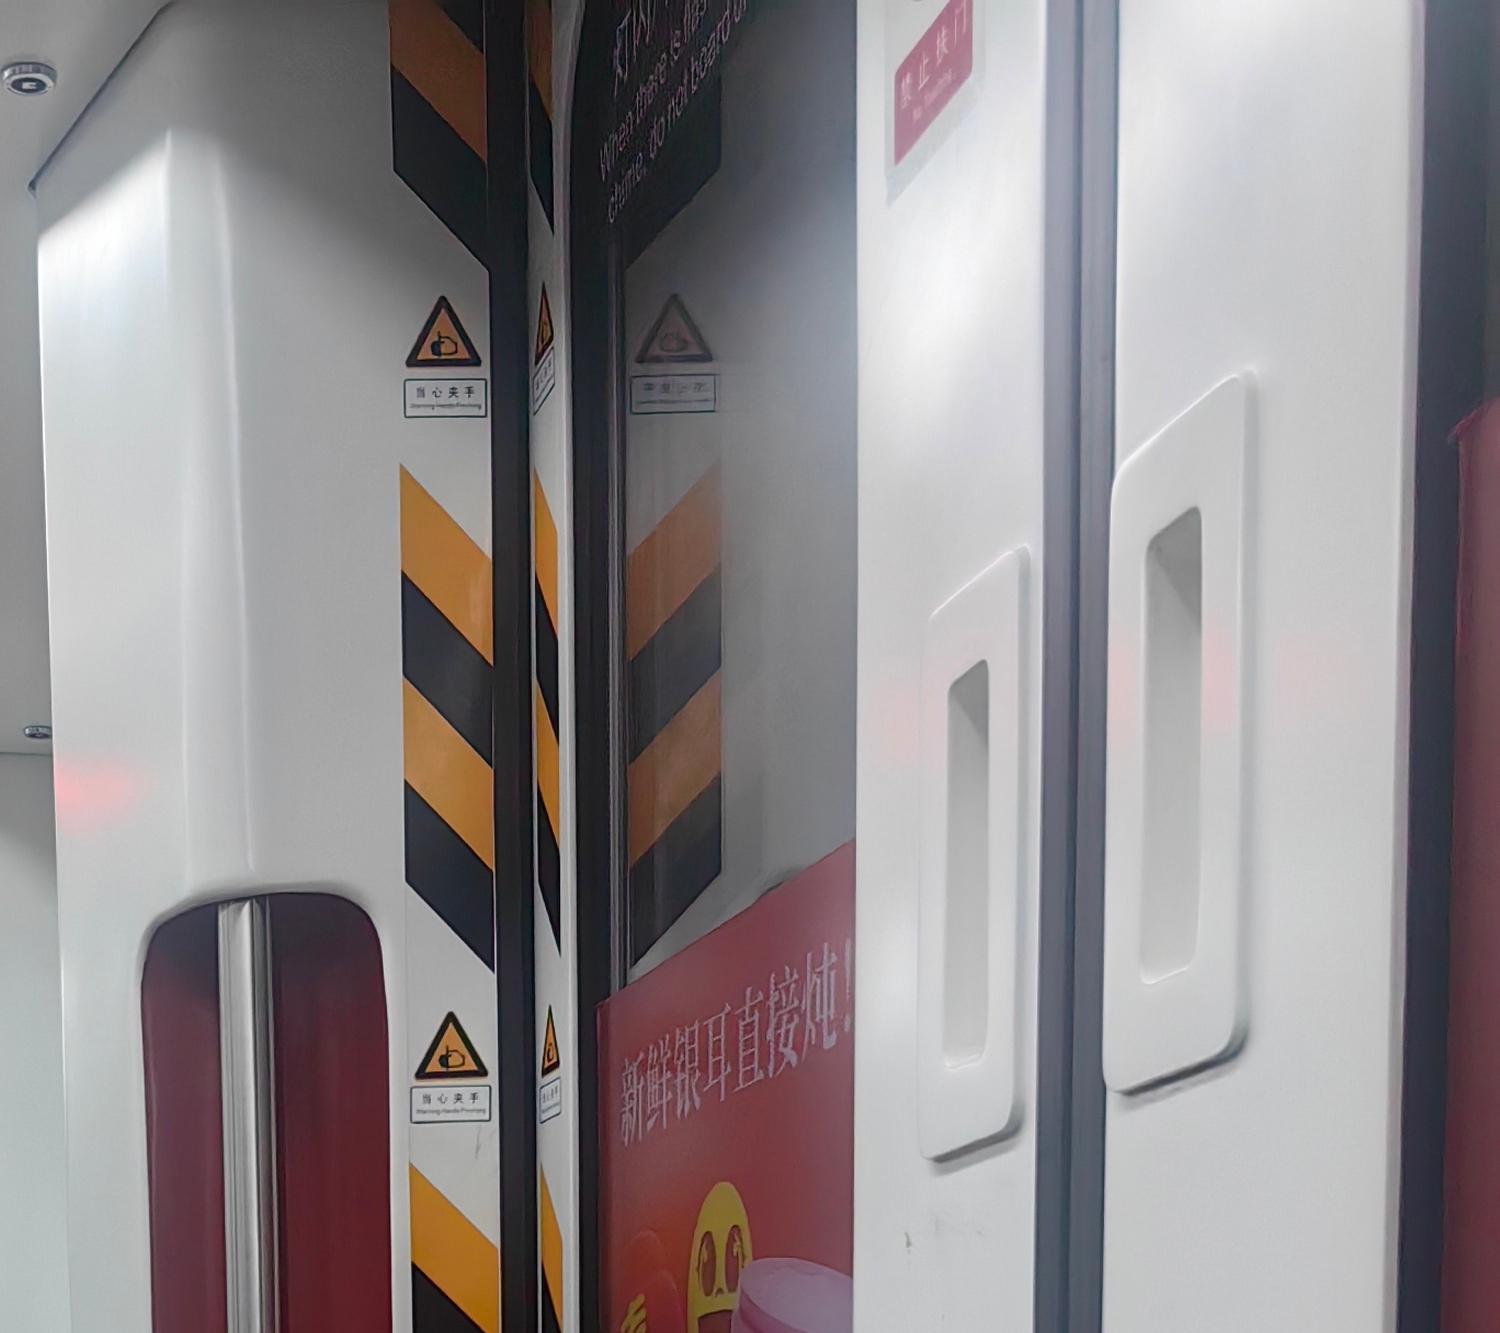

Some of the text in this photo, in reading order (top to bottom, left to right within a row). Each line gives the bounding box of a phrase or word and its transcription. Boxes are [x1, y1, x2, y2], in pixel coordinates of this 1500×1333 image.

[600, 111, 633, 182] When
[636, 53, 667, 125] there
[670, 30, 681, 67] is
[649, 115, 666, 160] do
[668, 68, 689, 131] not
[691, 0, 730, 94] board
[416, 386, 476, 399] 当心夹手
[422, 1092, 479, 1104] 当心夹手
